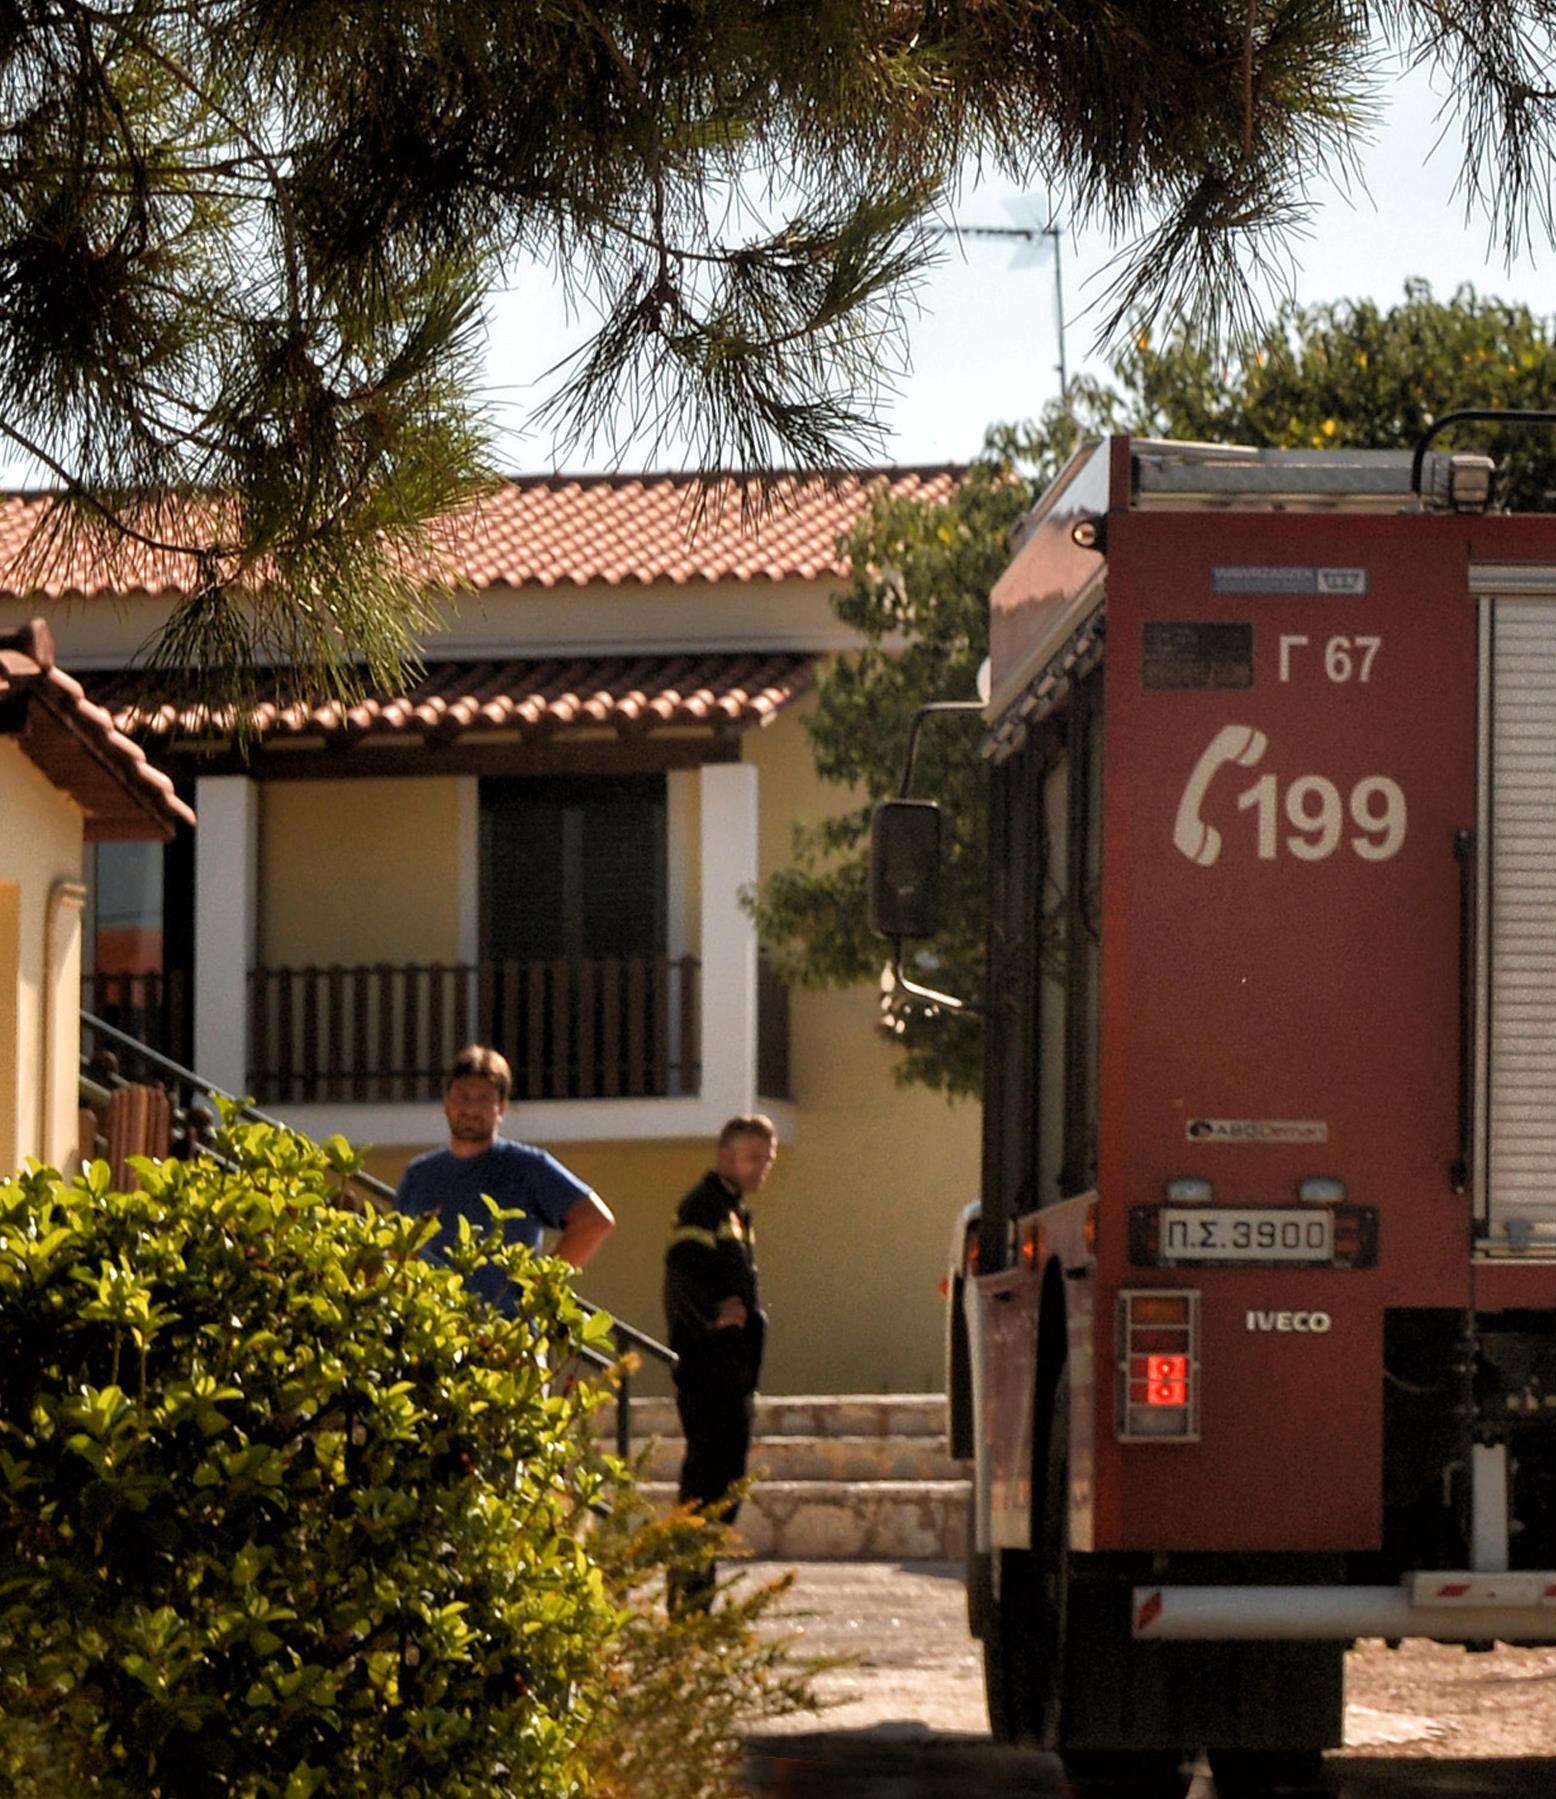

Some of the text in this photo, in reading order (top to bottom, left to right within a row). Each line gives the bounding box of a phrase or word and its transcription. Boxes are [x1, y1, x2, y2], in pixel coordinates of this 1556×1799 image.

[1279, 635, 1308, 682] Γ
[1324, 635, 1382, 683] 67
[1237, 774, 1408, 861] 199
[1246, 1311, 1332, 1333] IVECO
